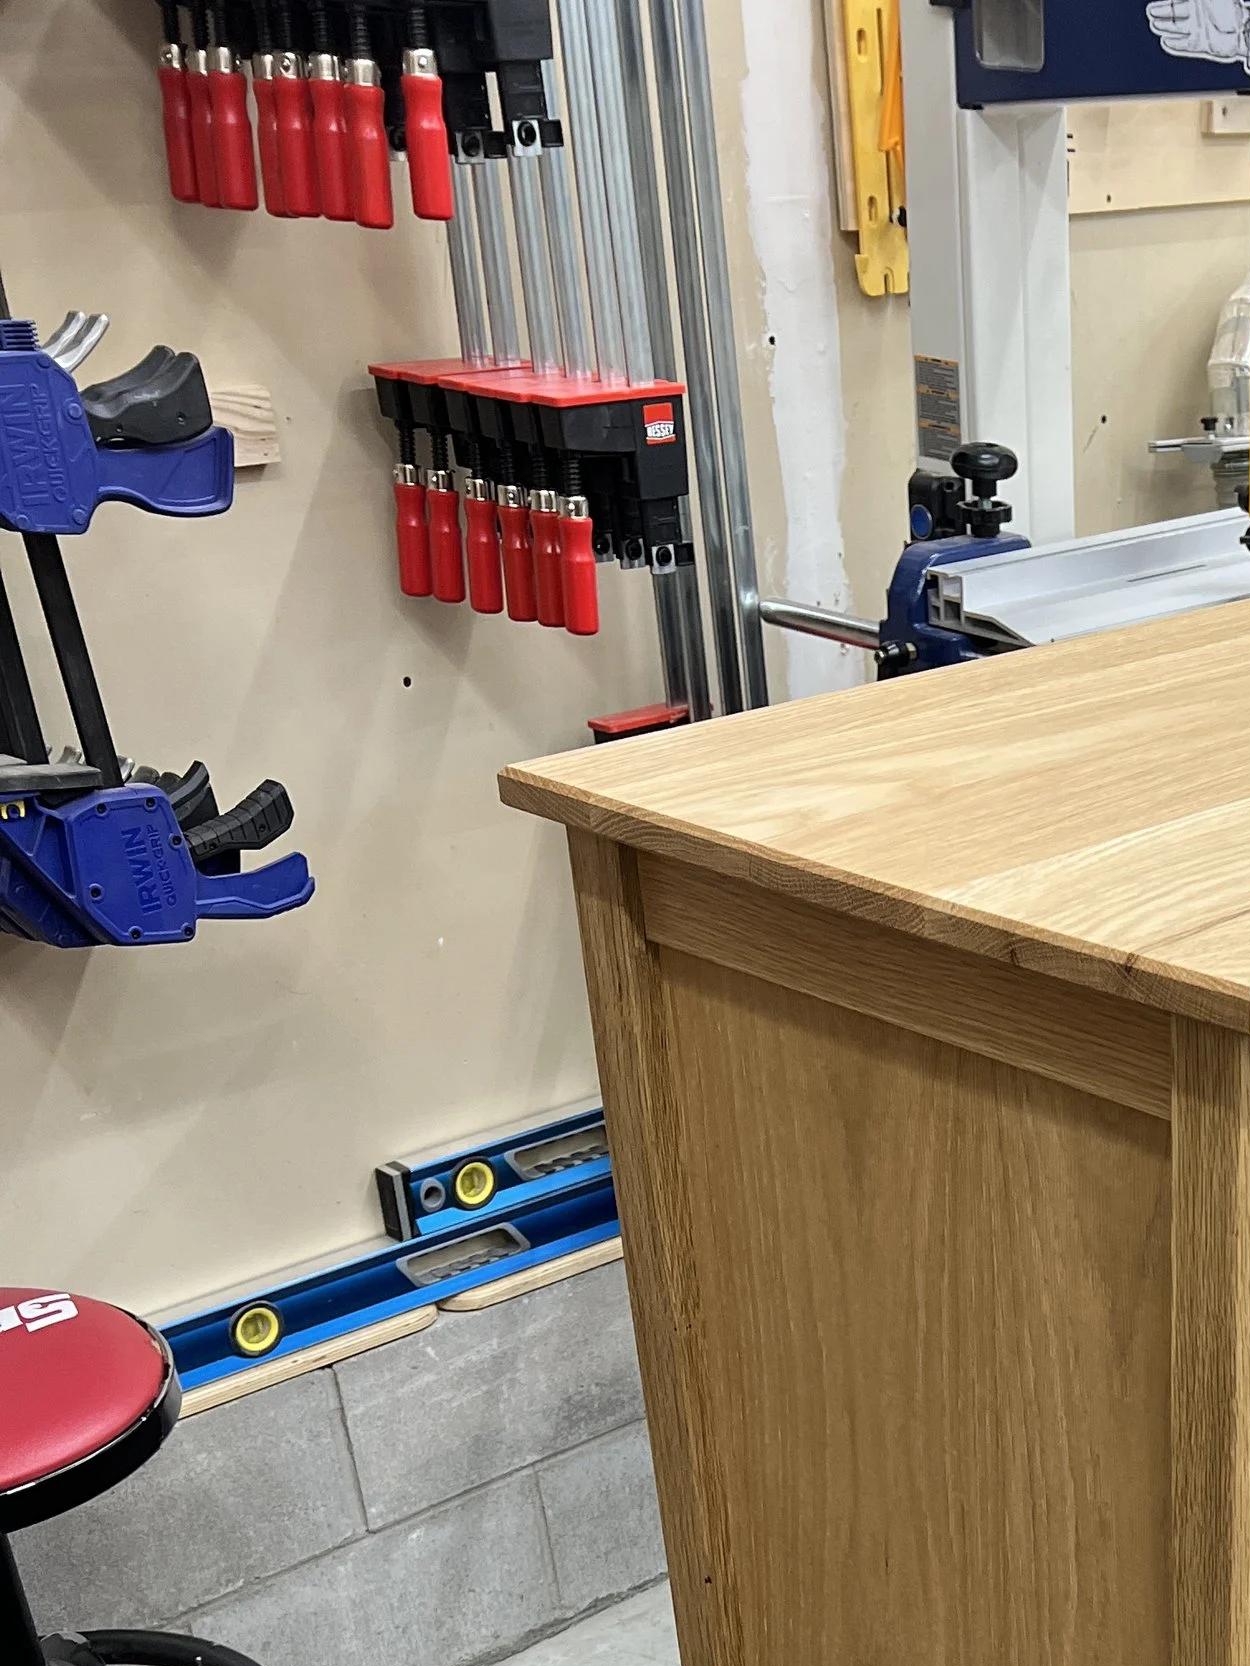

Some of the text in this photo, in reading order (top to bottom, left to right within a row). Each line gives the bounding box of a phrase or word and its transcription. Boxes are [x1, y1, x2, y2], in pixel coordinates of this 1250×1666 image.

[0, 383, 50, 508] IRWIN
[646, 423, 674, 438] BESSEY
[121, 826, 162, 916] IRWIN
